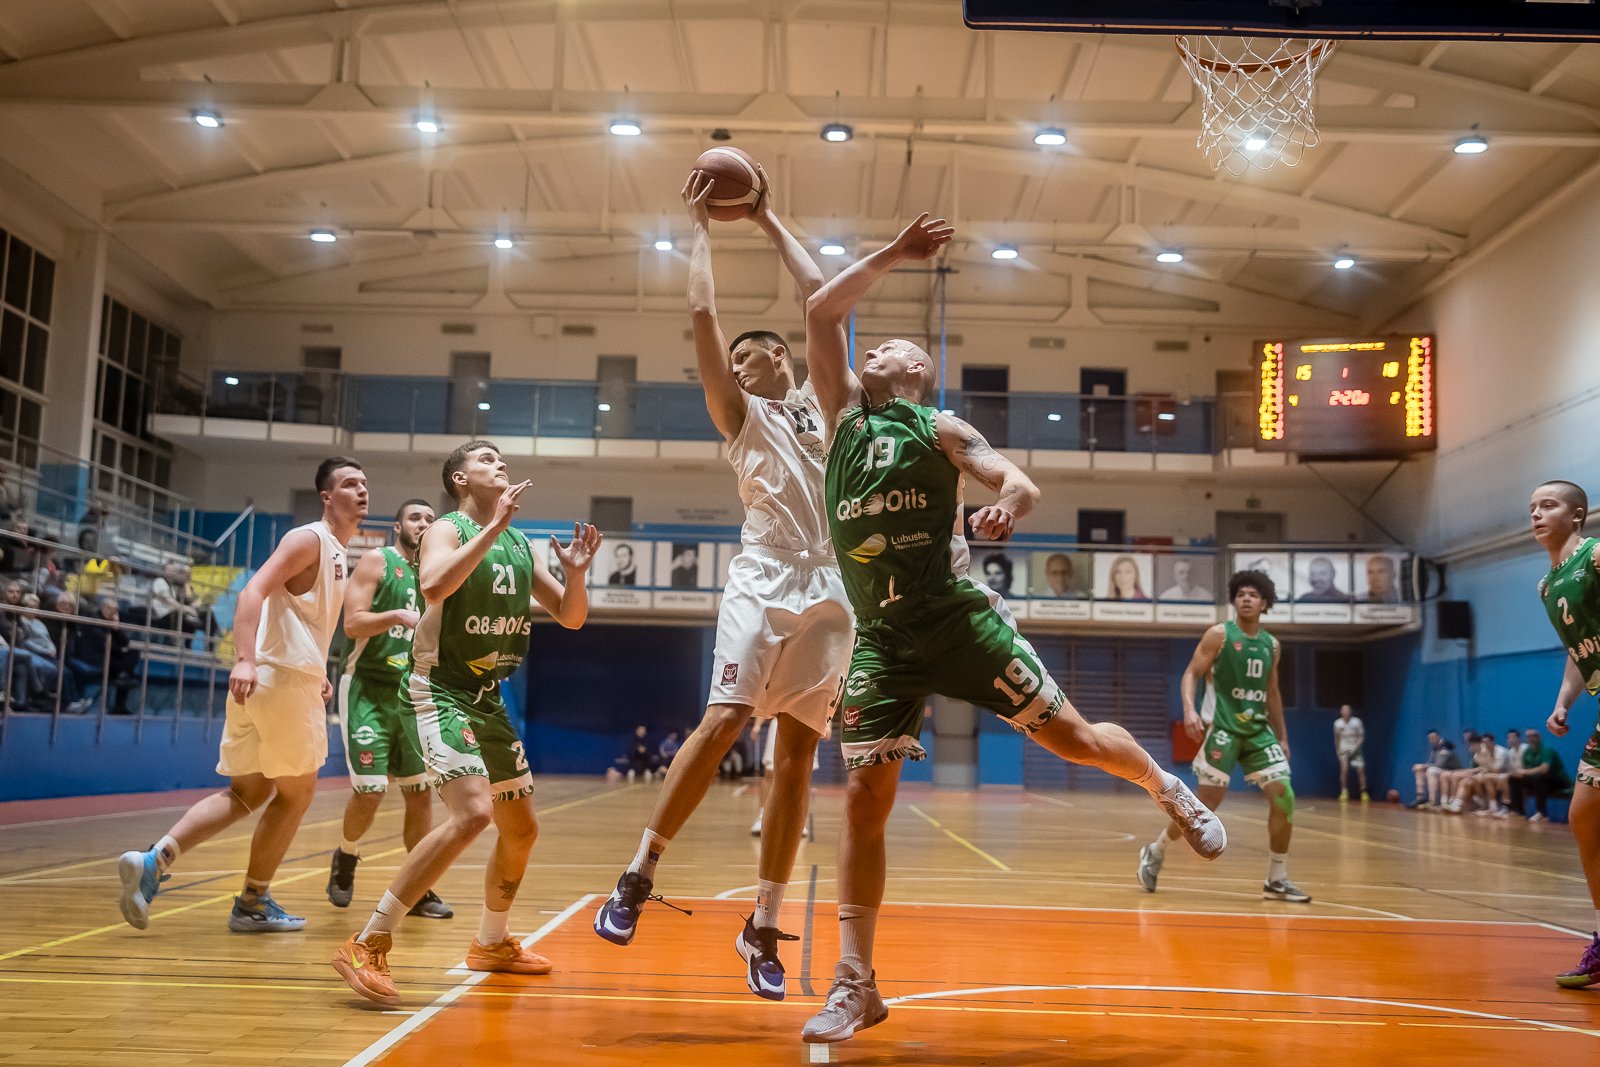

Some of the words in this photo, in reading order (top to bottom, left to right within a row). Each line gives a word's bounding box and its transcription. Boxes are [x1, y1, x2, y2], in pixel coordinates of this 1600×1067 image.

[863, 436, 896, 471] 19
[836, 498, 862, 520] Q8
[885, 488, 927, 512] Oils
[891, 531, 930, 545] Lubuskie
[492, 564, 517, 595] 21
[465, 615, 490, 635] Q8
[1557, 596, 1574, 625] 2
[993, 657, 1040, 706] 19
[1246, 658, 1263, 678] 10
[1264, 744, 1286, 762] 10
